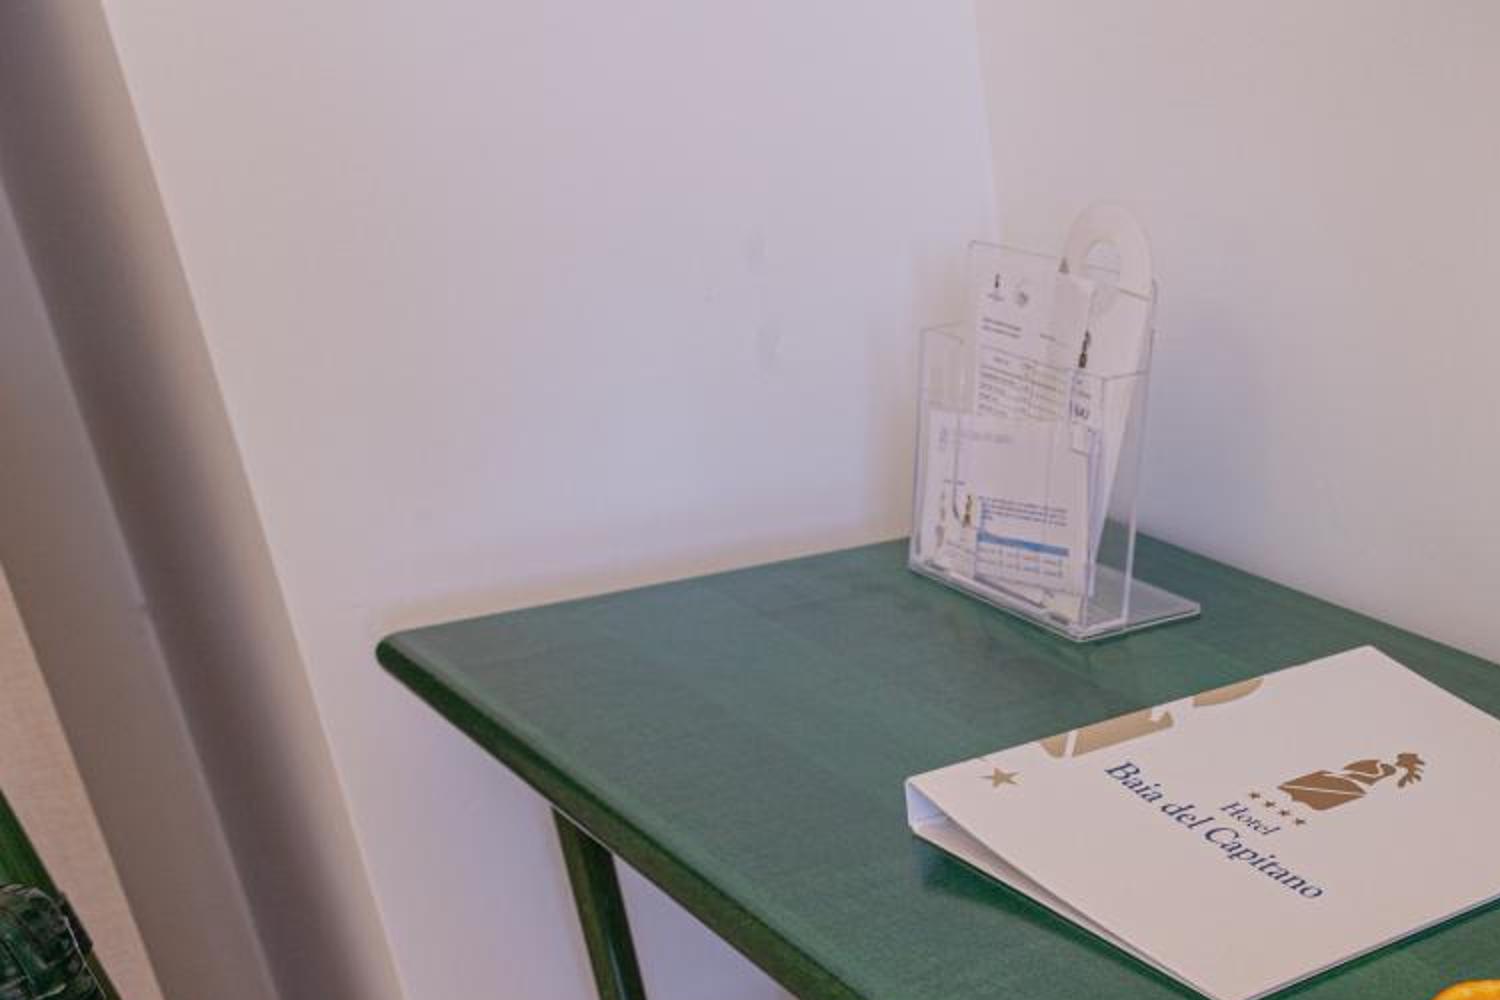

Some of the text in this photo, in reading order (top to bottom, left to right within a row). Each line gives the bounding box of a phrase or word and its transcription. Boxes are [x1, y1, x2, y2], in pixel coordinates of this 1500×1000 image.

[1104, 760, 1324, 899] Baia del Capitano
[1220, 801, 1281, 836] Hotel
